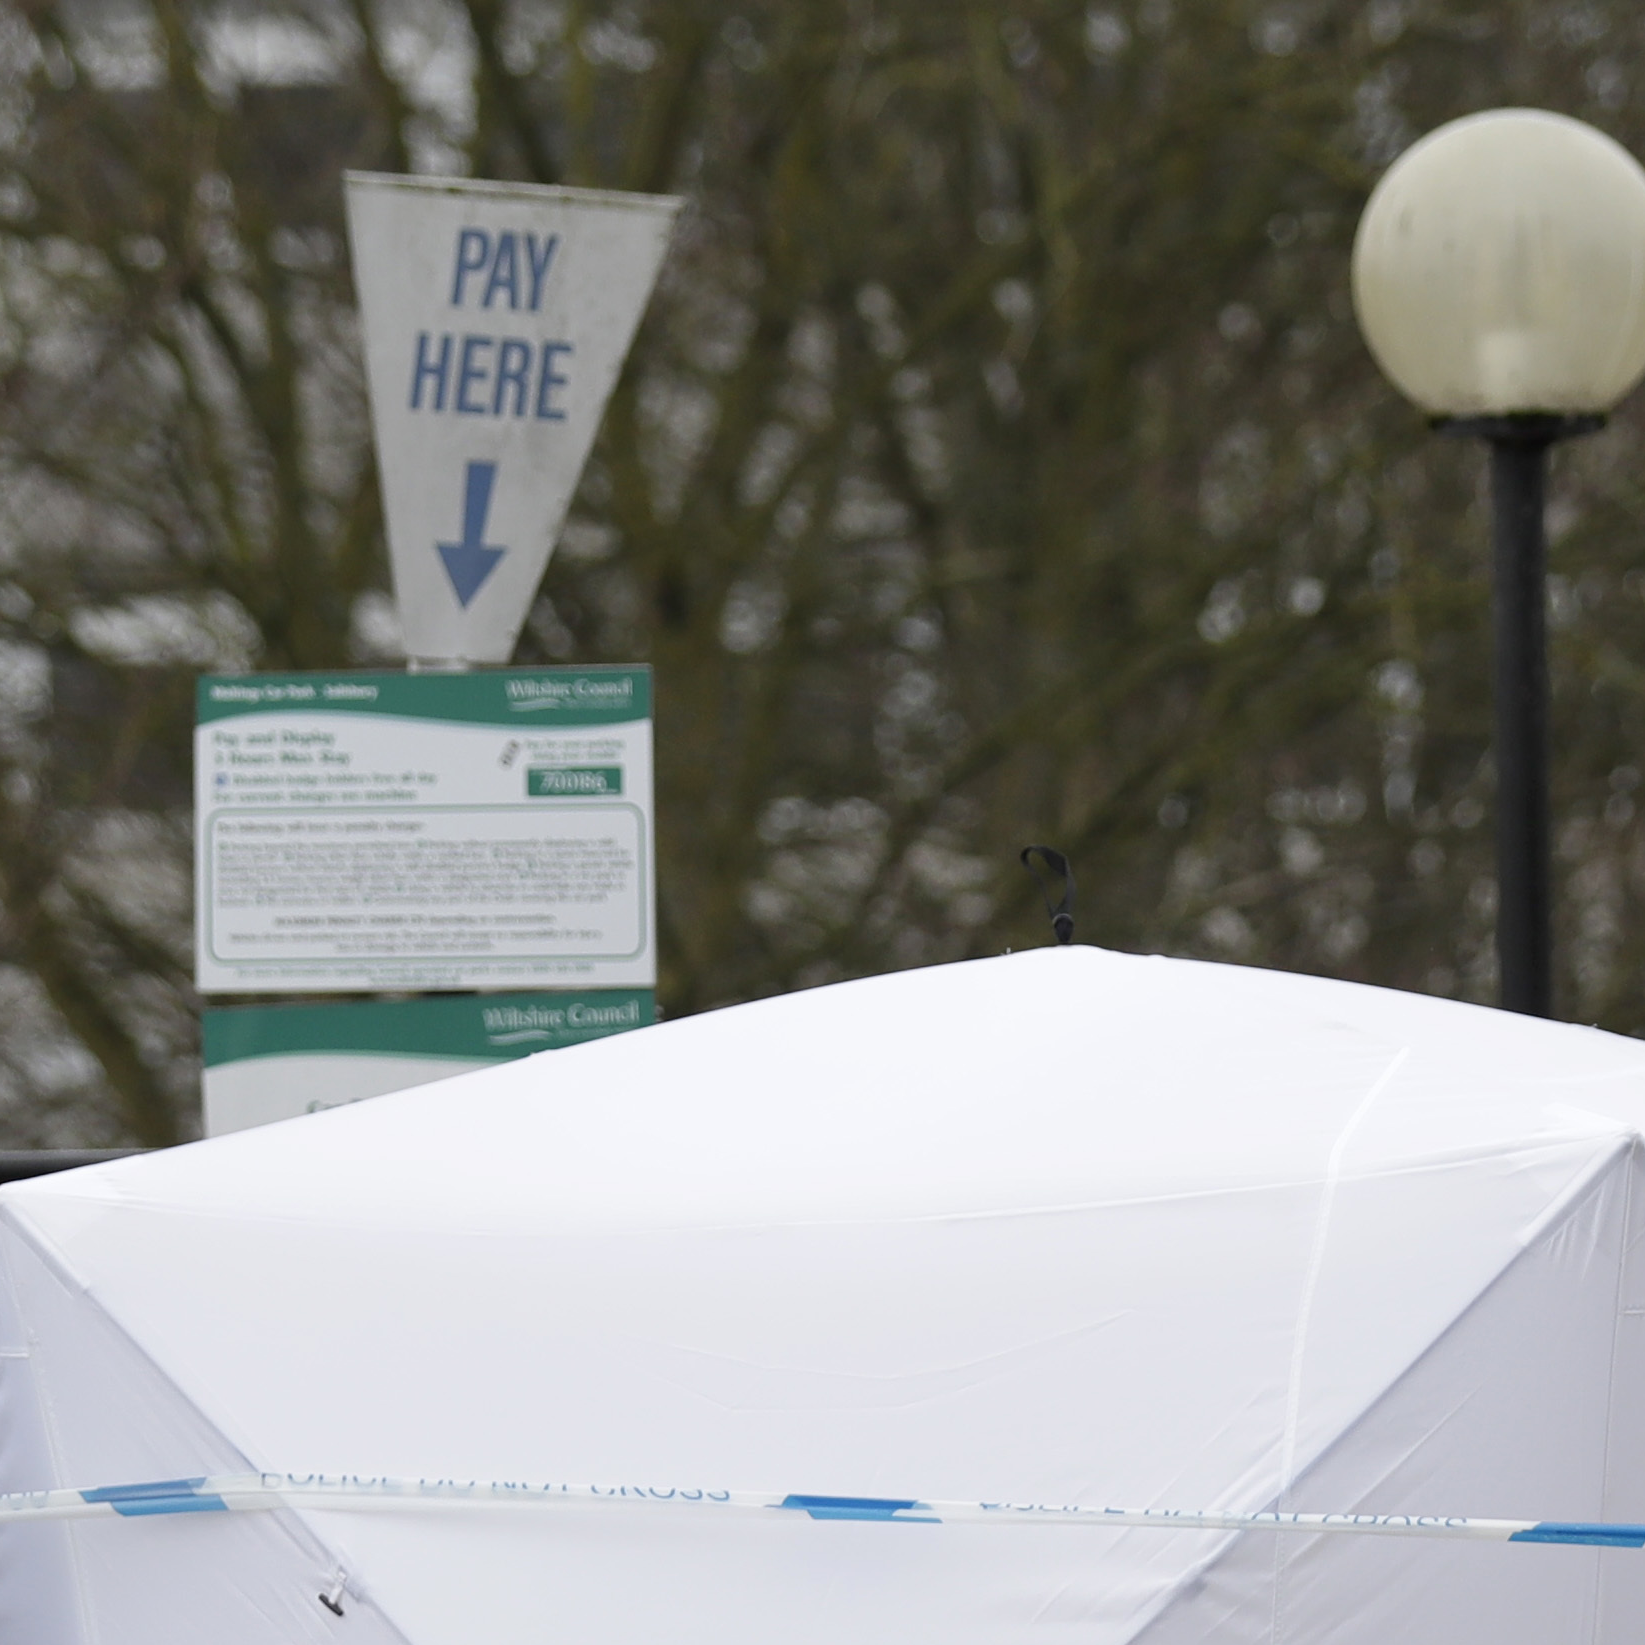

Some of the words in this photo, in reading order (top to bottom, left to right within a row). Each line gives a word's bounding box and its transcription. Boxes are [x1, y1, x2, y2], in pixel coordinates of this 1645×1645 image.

[451, 229, 557, 311] PAY
[410, 333, 573, 421] HERE
[504, 678, 574, 698] Wiltshire
[576, 677, 633, 697] Council
[482, 1004, 565, 1031] Wiltshire
[567, 999, 640, 1028] Council
